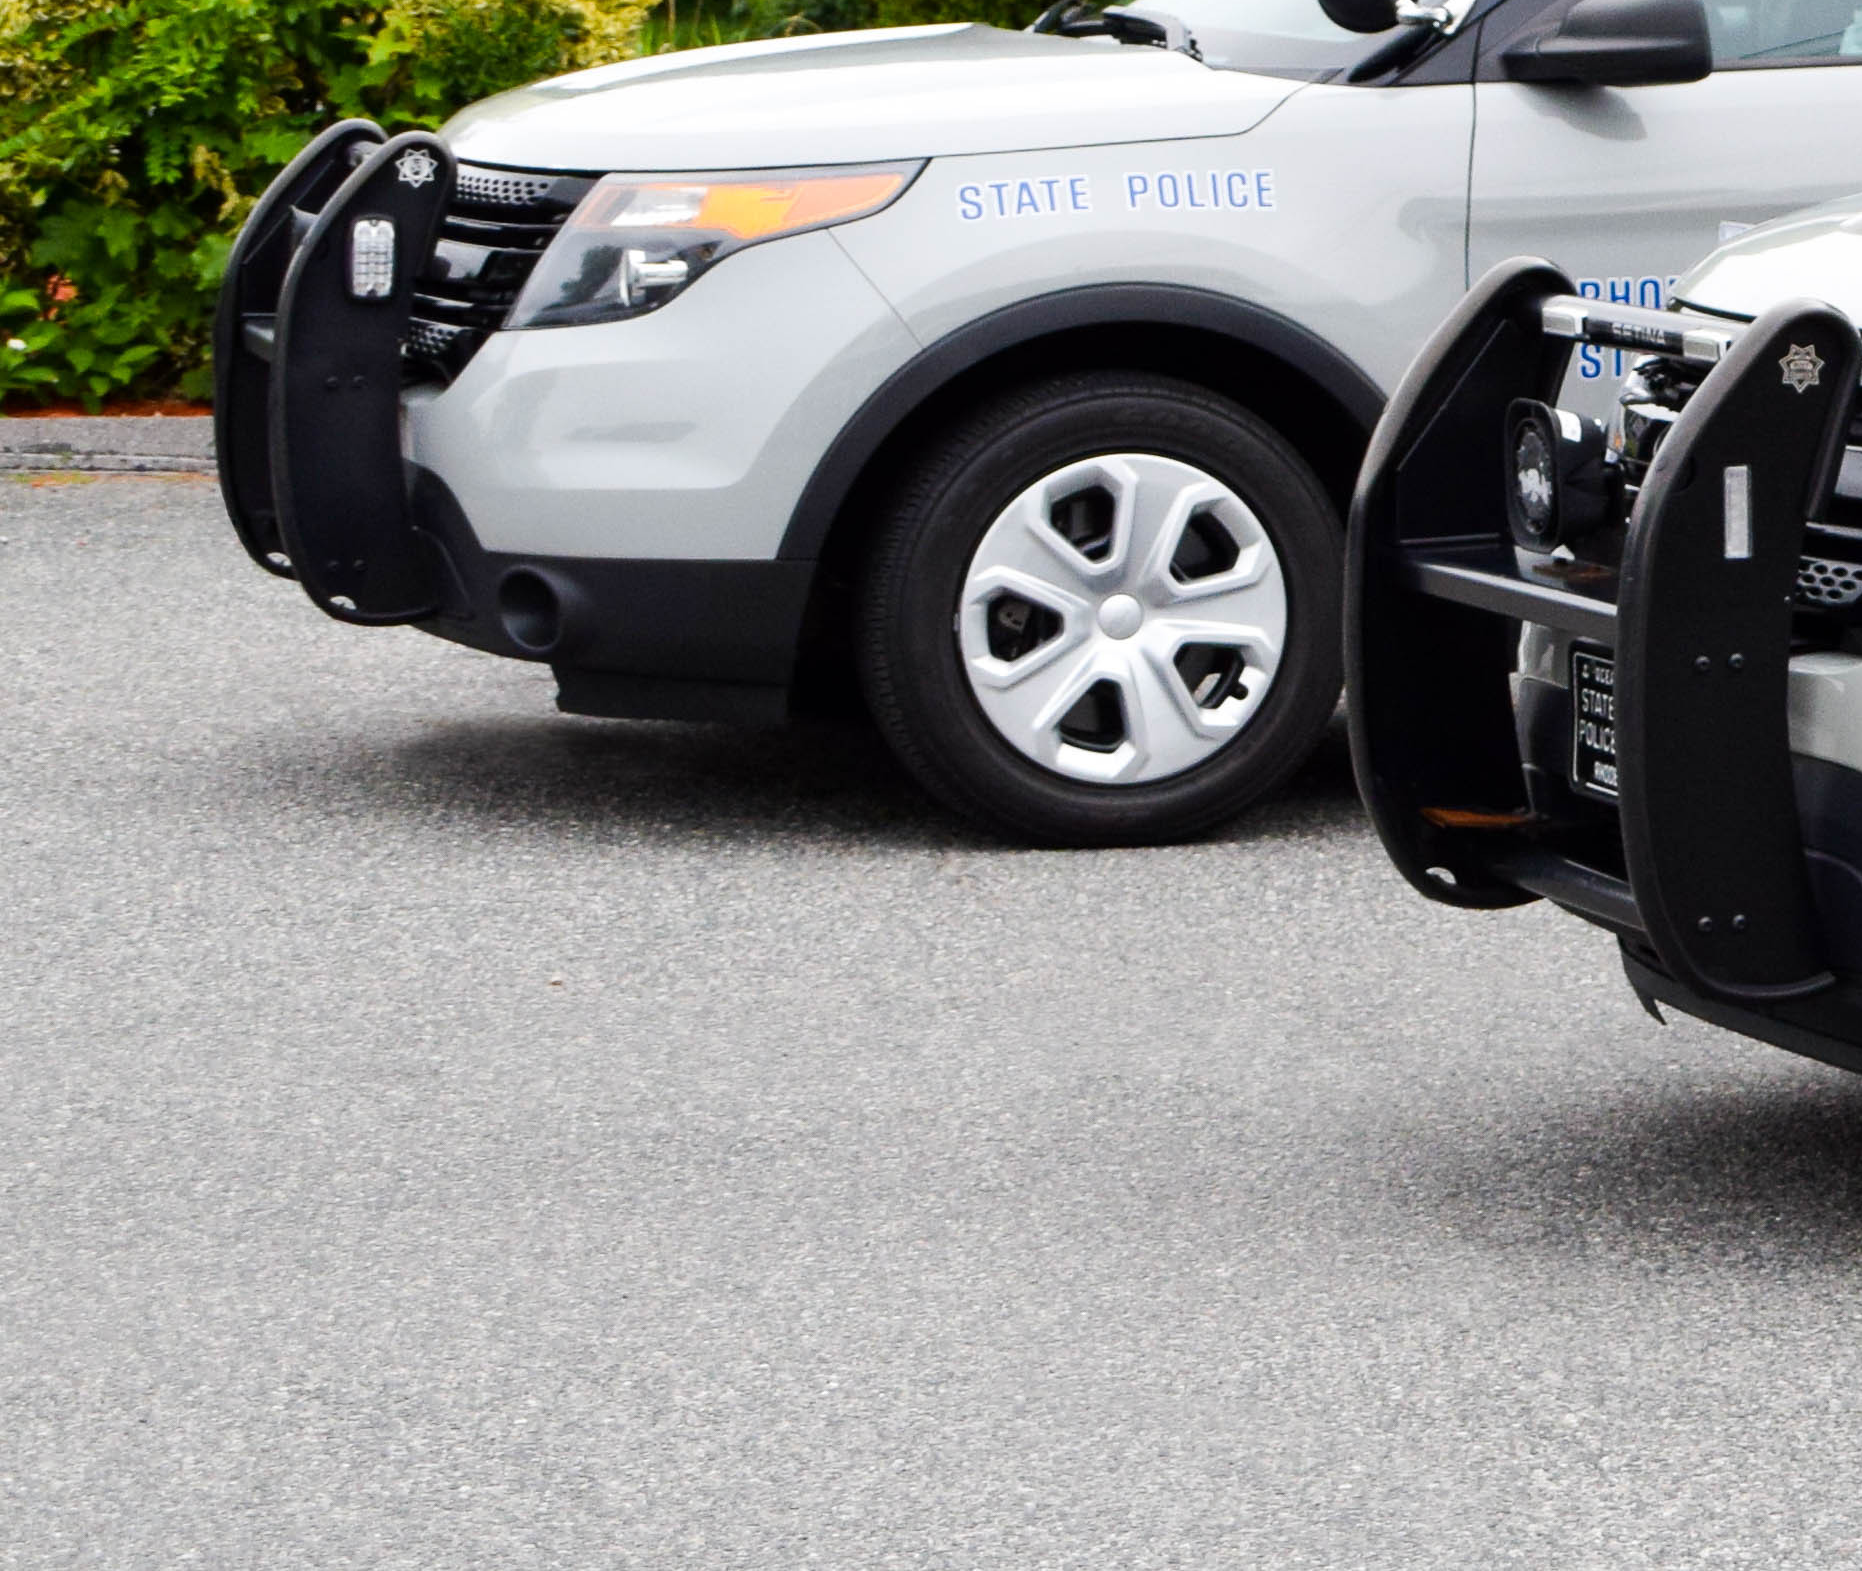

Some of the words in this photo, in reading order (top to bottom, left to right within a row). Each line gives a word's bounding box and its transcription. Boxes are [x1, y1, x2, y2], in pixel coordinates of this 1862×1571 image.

[958, 176, 1090, 222] STATE
[1126, 170, 1273, 209] POLICE
[1582, 688, 1615, 720] STATE
[1579, 719, 1616, 754] POLICE
